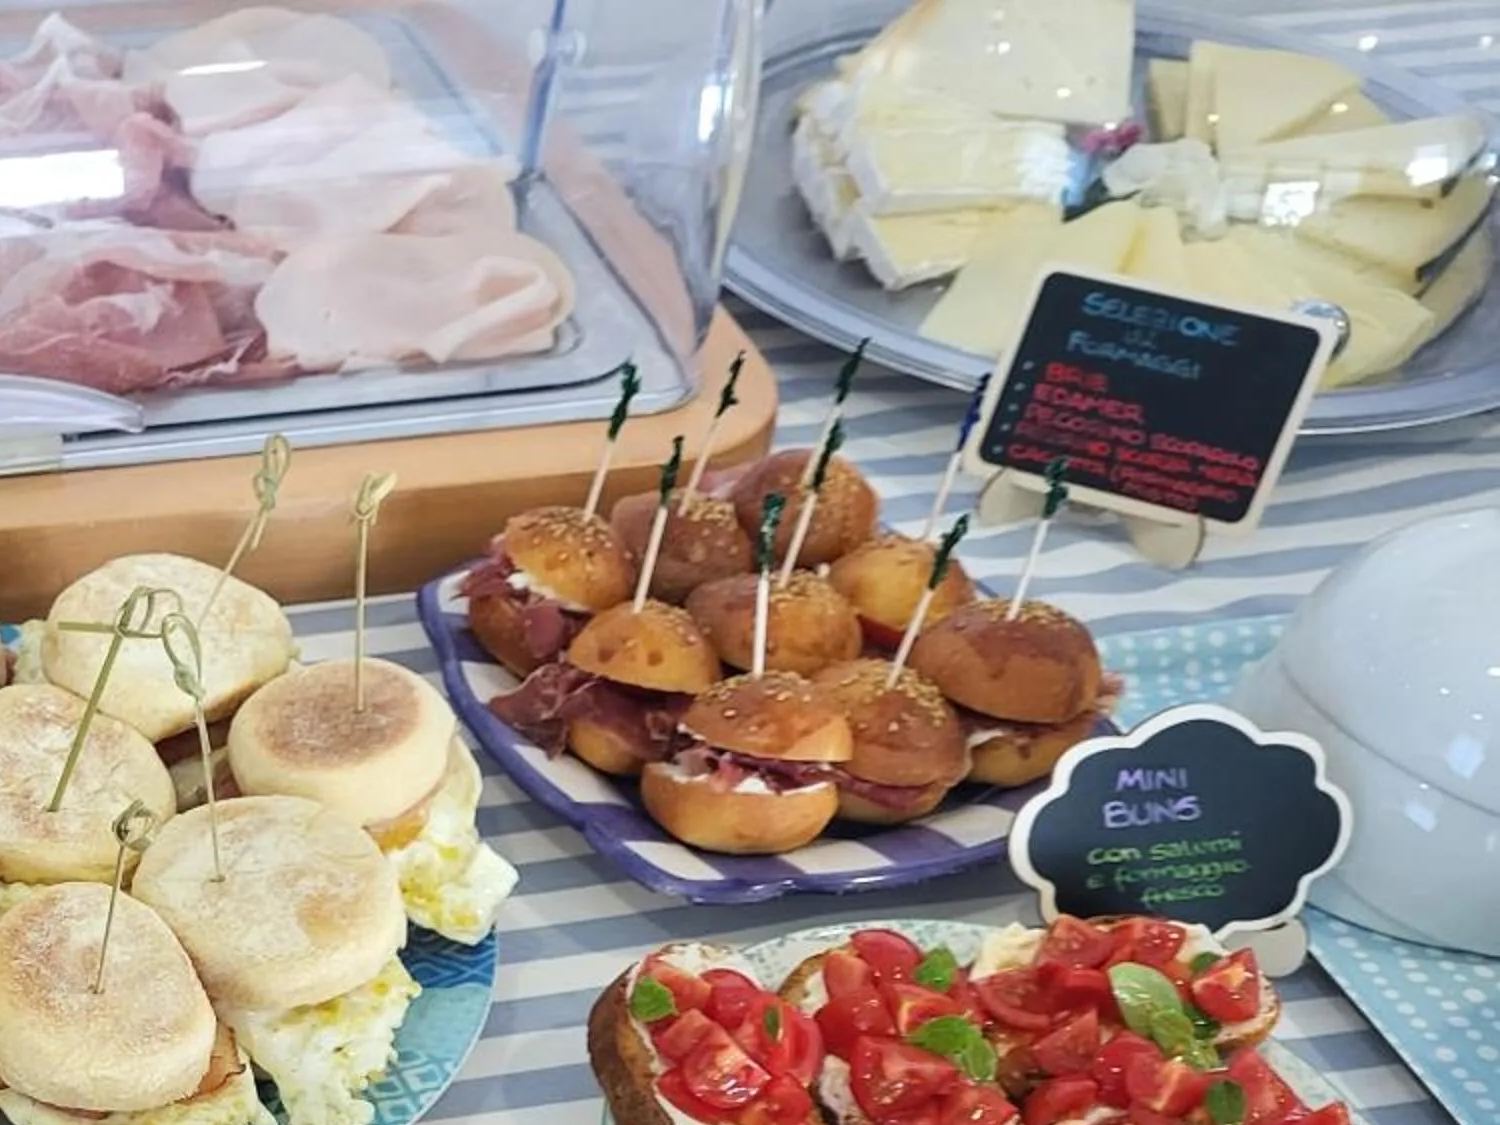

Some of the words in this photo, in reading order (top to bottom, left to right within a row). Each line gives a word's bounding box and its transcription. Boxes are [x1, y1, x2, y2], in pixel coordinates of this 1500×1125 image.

[1045, 361, 1110, 394] BRIE
[1032, 382, 1145, 425] EDAMER
[1115, 767, 1189, 793] MINI
[1101, 794, 1202, 830] BUNS
[1089, 847, 1140, 864] con
